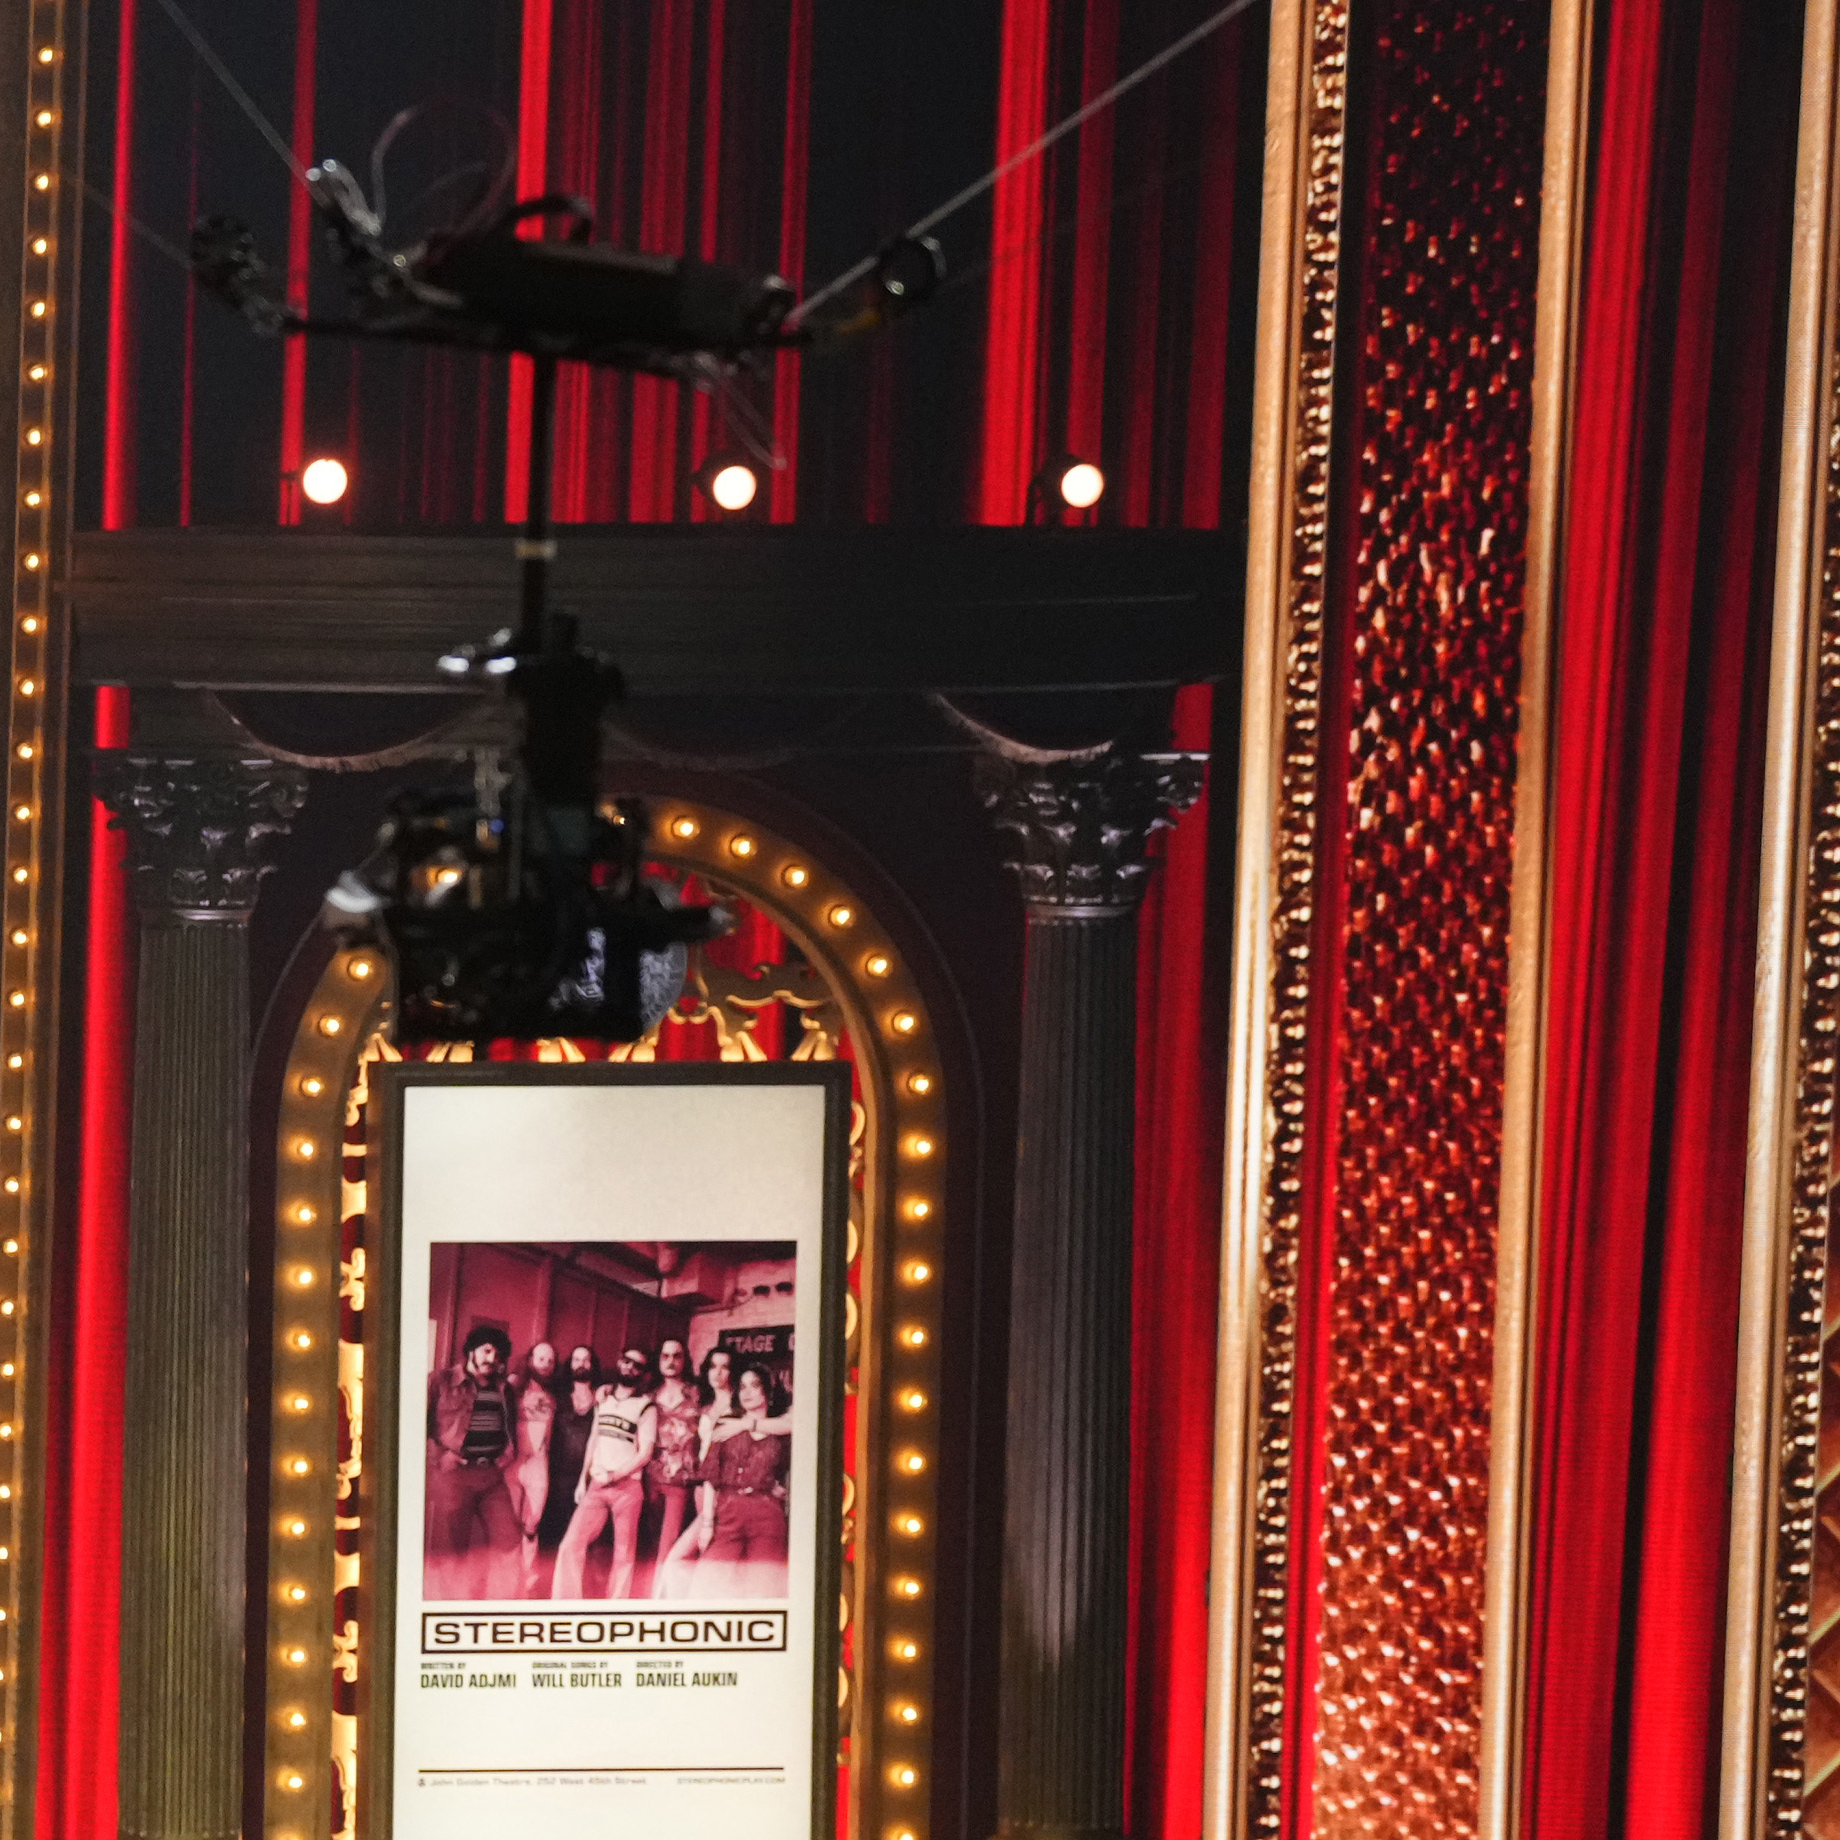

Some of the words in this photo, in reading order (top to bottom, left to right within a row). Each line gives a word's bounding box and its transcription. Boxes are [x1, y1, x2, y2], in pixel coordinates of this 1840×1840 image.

[434, 1619, 775, 1646] STEREOPHONIC
[421, 1674, 464, 1688] DAVID
[469, 1674, 517, 1688] ADJMI
[532, 1673, 564, 1688] WILL
[570, 1673, 622, 1688] BUTLER
[636, 1672, 687, 1687] DANIEL
[691, 1672, 738, 1687] AUKIN
